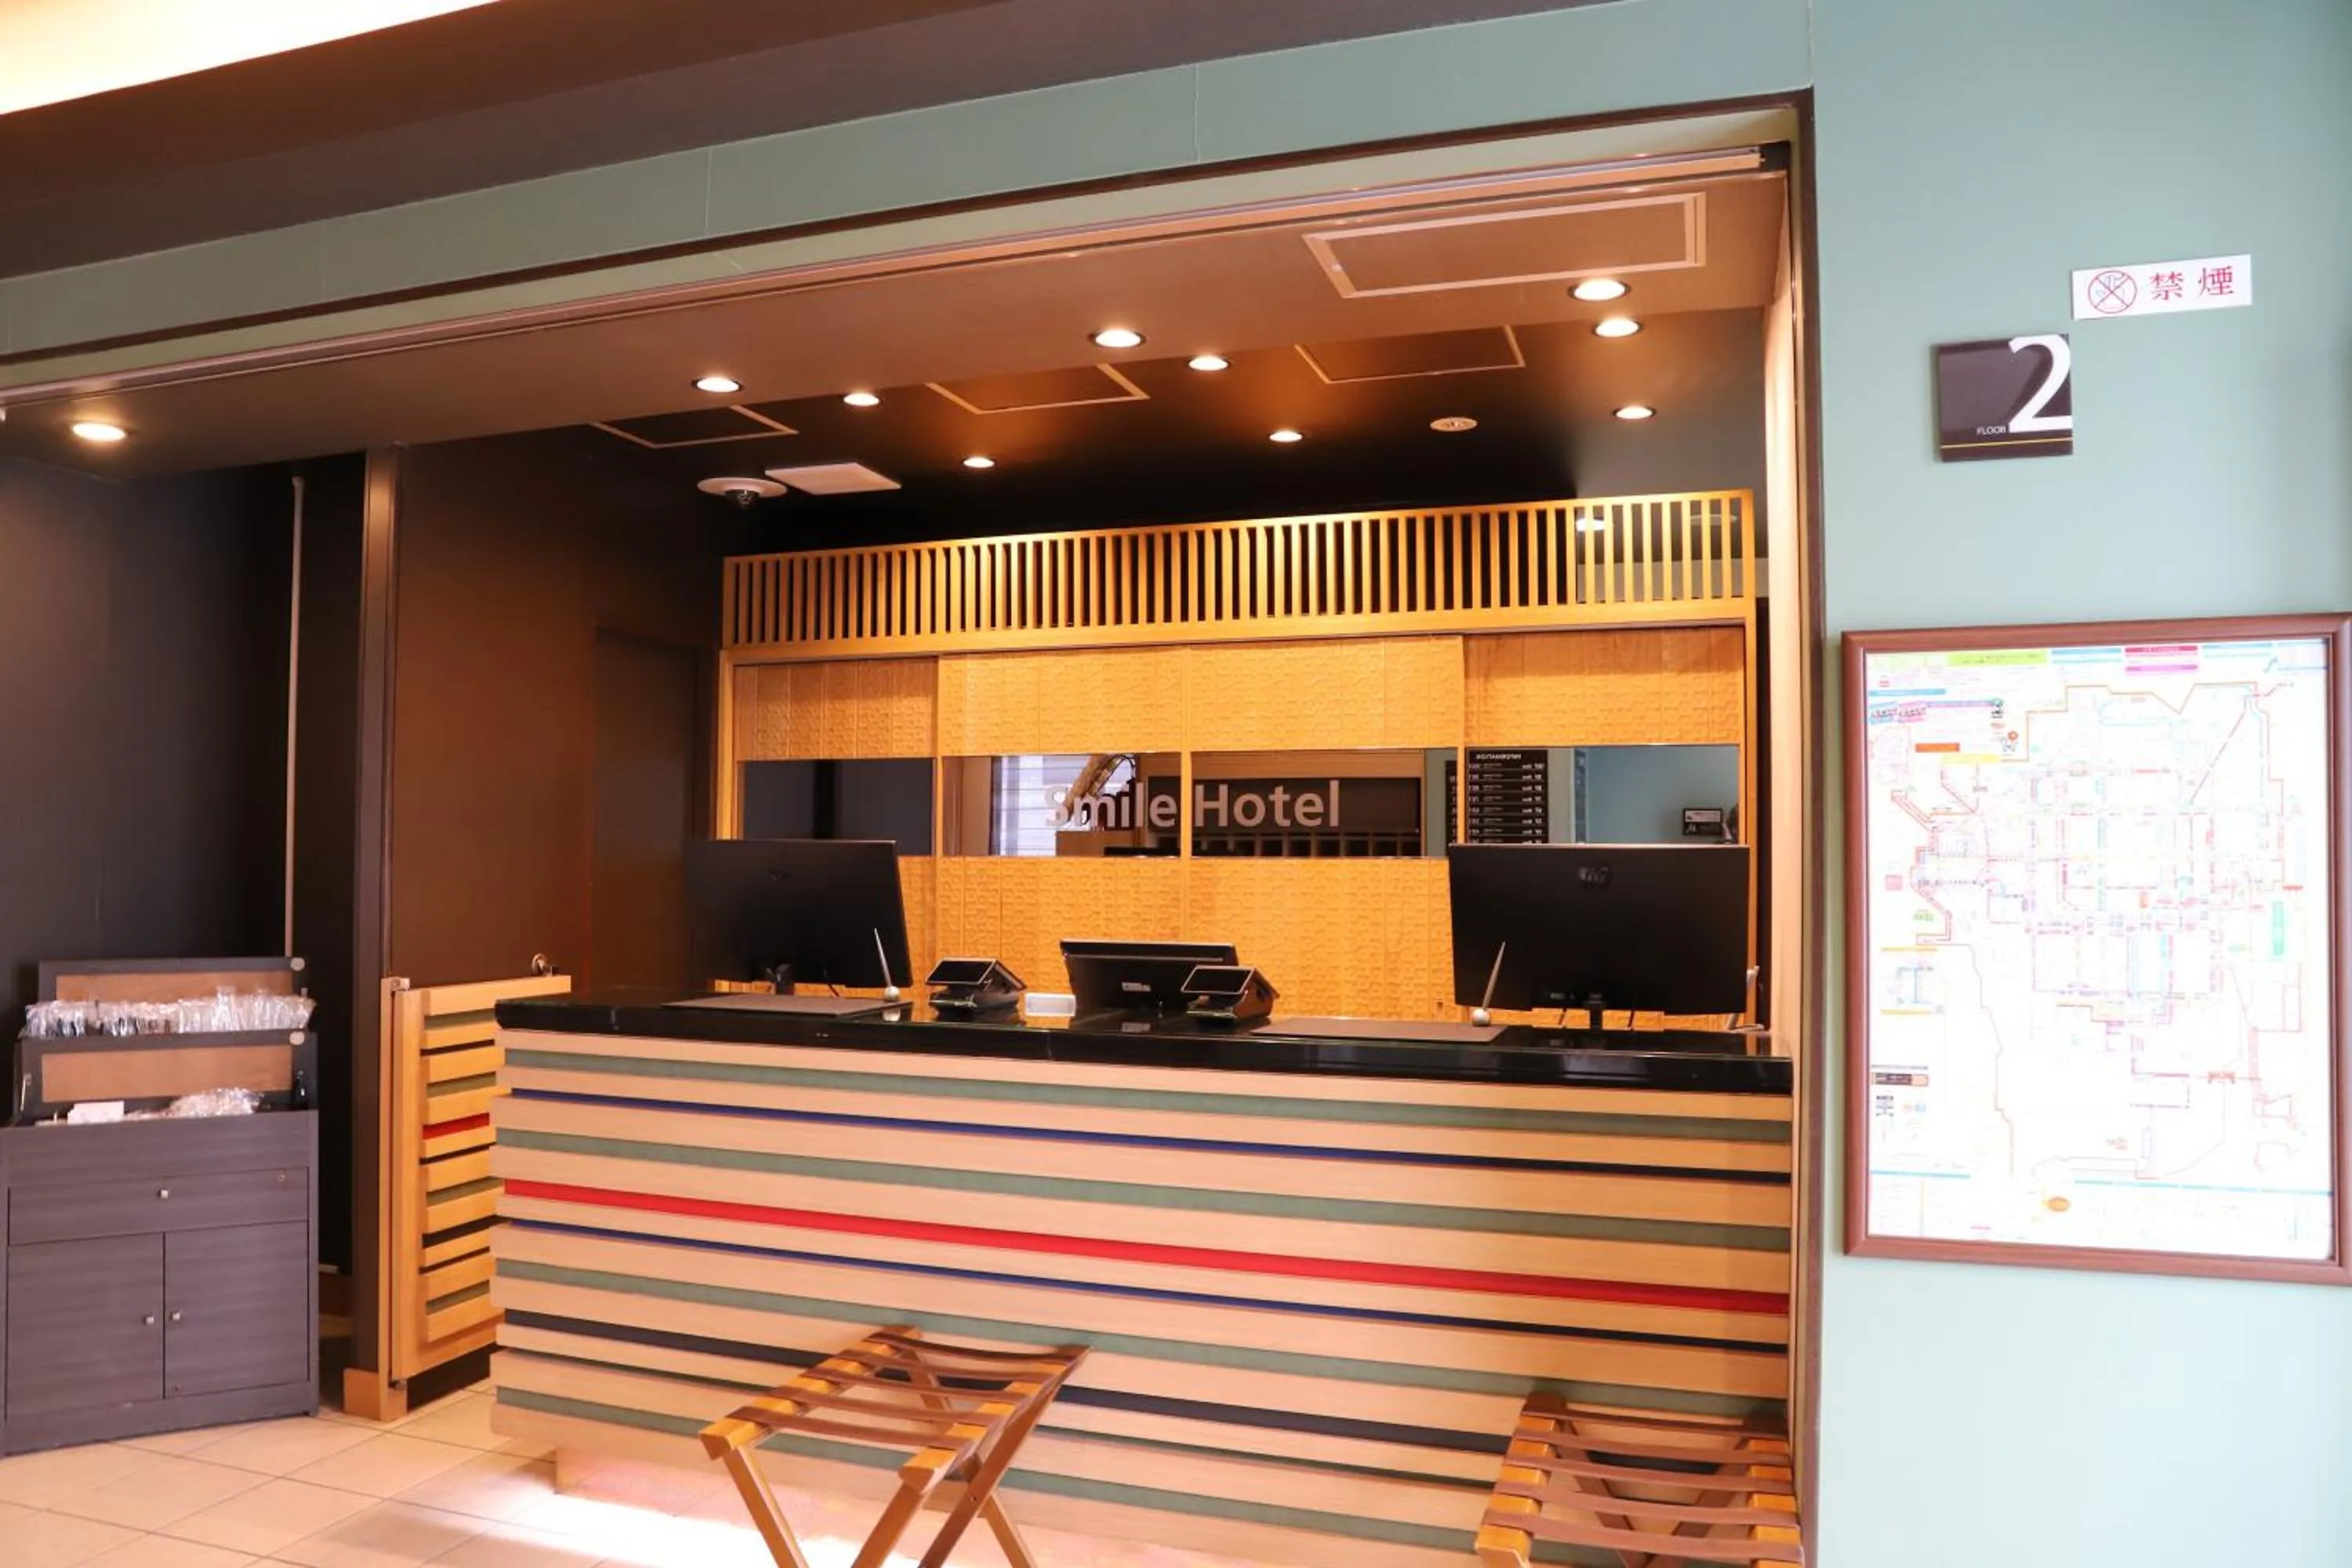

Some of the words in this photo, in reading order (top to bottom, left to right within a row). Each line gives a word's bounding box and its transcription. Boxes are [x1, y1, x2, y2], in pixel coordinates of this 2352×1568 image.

[2148, 265, 2235, 301] 禁煙
[2008, 333, 2074, 433] 2
[1976, 426, 2006, 435] FLOOR
[1044, 781, 1178, 828] Smile
[1194, 779, 1339, 828] Hotel
